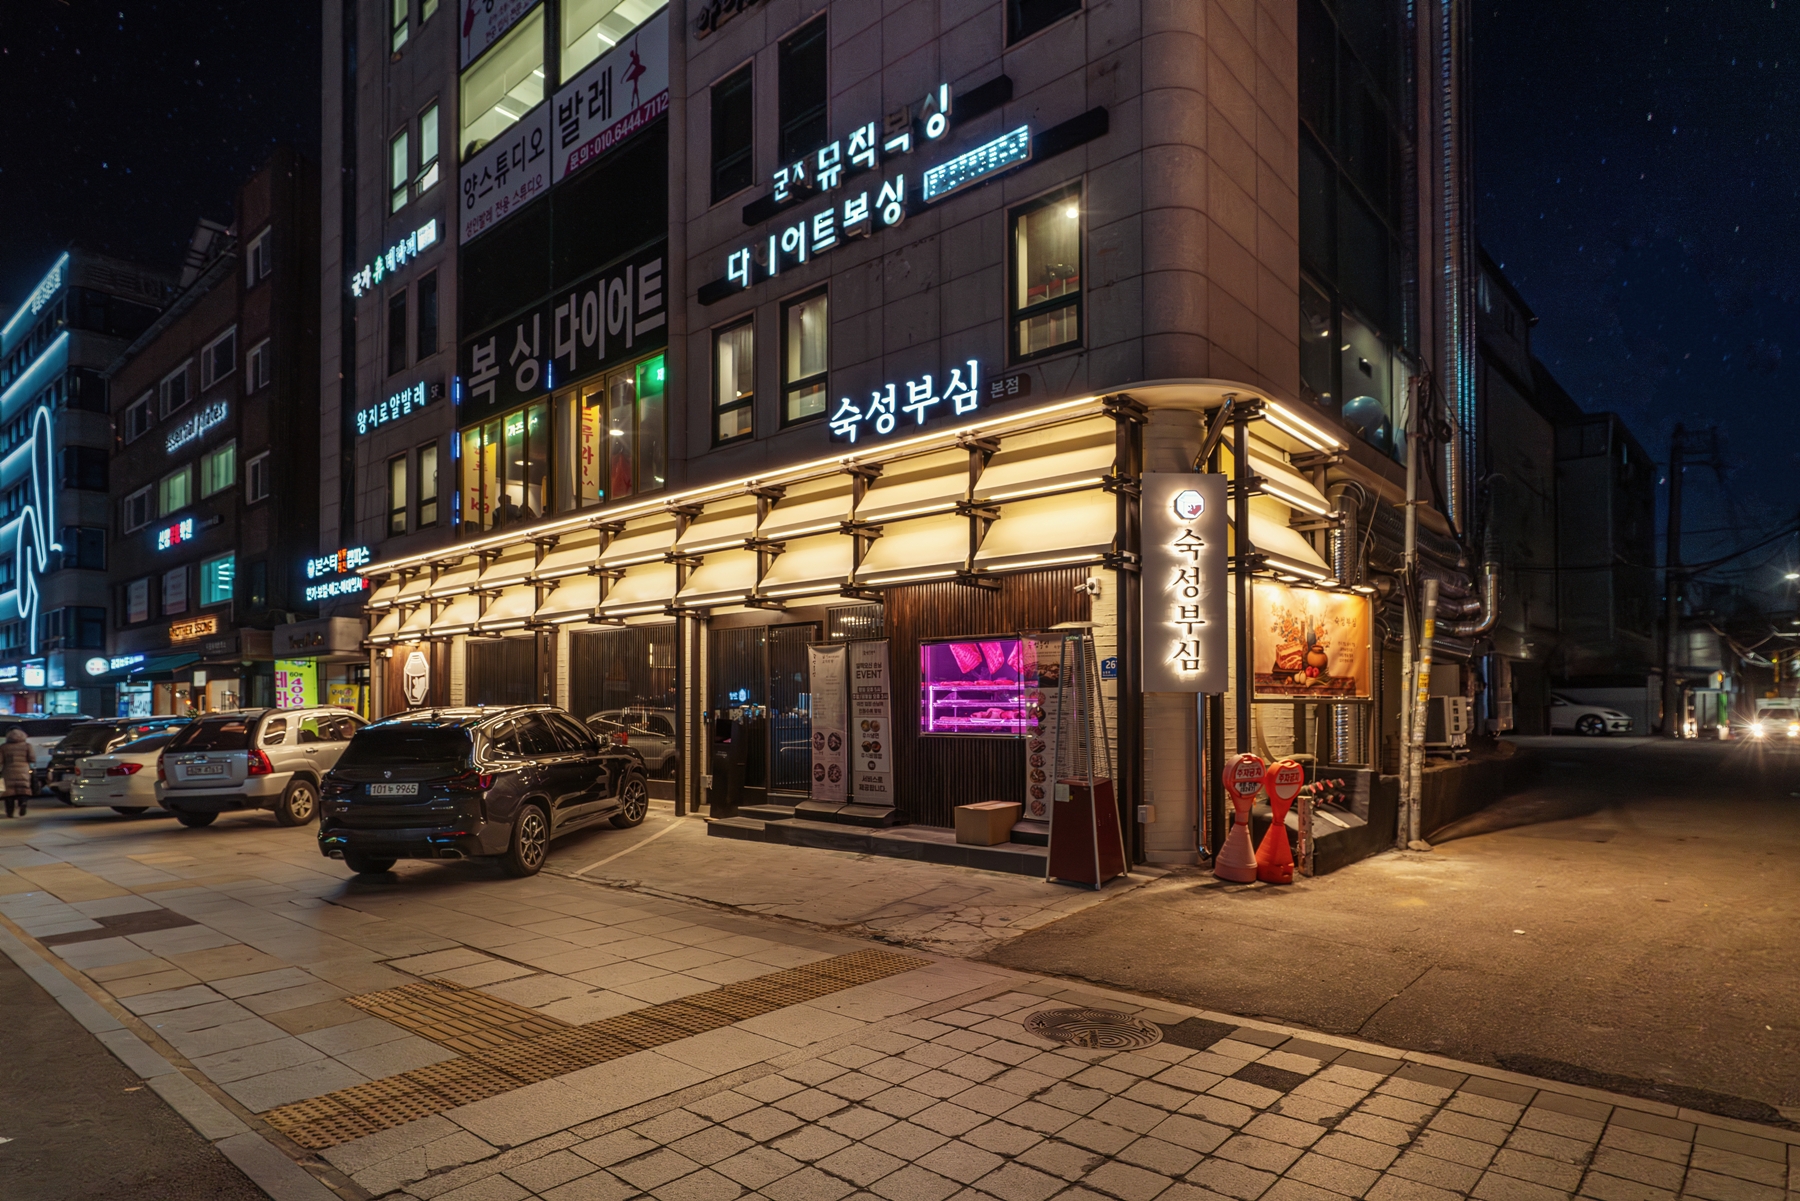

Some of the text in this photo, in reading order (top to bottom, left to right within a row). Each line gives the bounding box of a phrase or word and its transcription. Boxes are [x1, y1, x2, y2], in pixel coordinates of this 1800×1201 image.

[559, 65, 613, 150] 발레
[463, 127, 546, 210] 양스튜디오
[468, 257, 667, 405] 복싱 다이어트
[357, 381, 425, 434] 왕지로얄발레
[829, 359, 1020, 444] 숙성부심 본점
[1172, 528, 1207, 672] 숙성부심
[856, 669, 882, 680] EVENT
[395, 783, 418, 794] 9965
